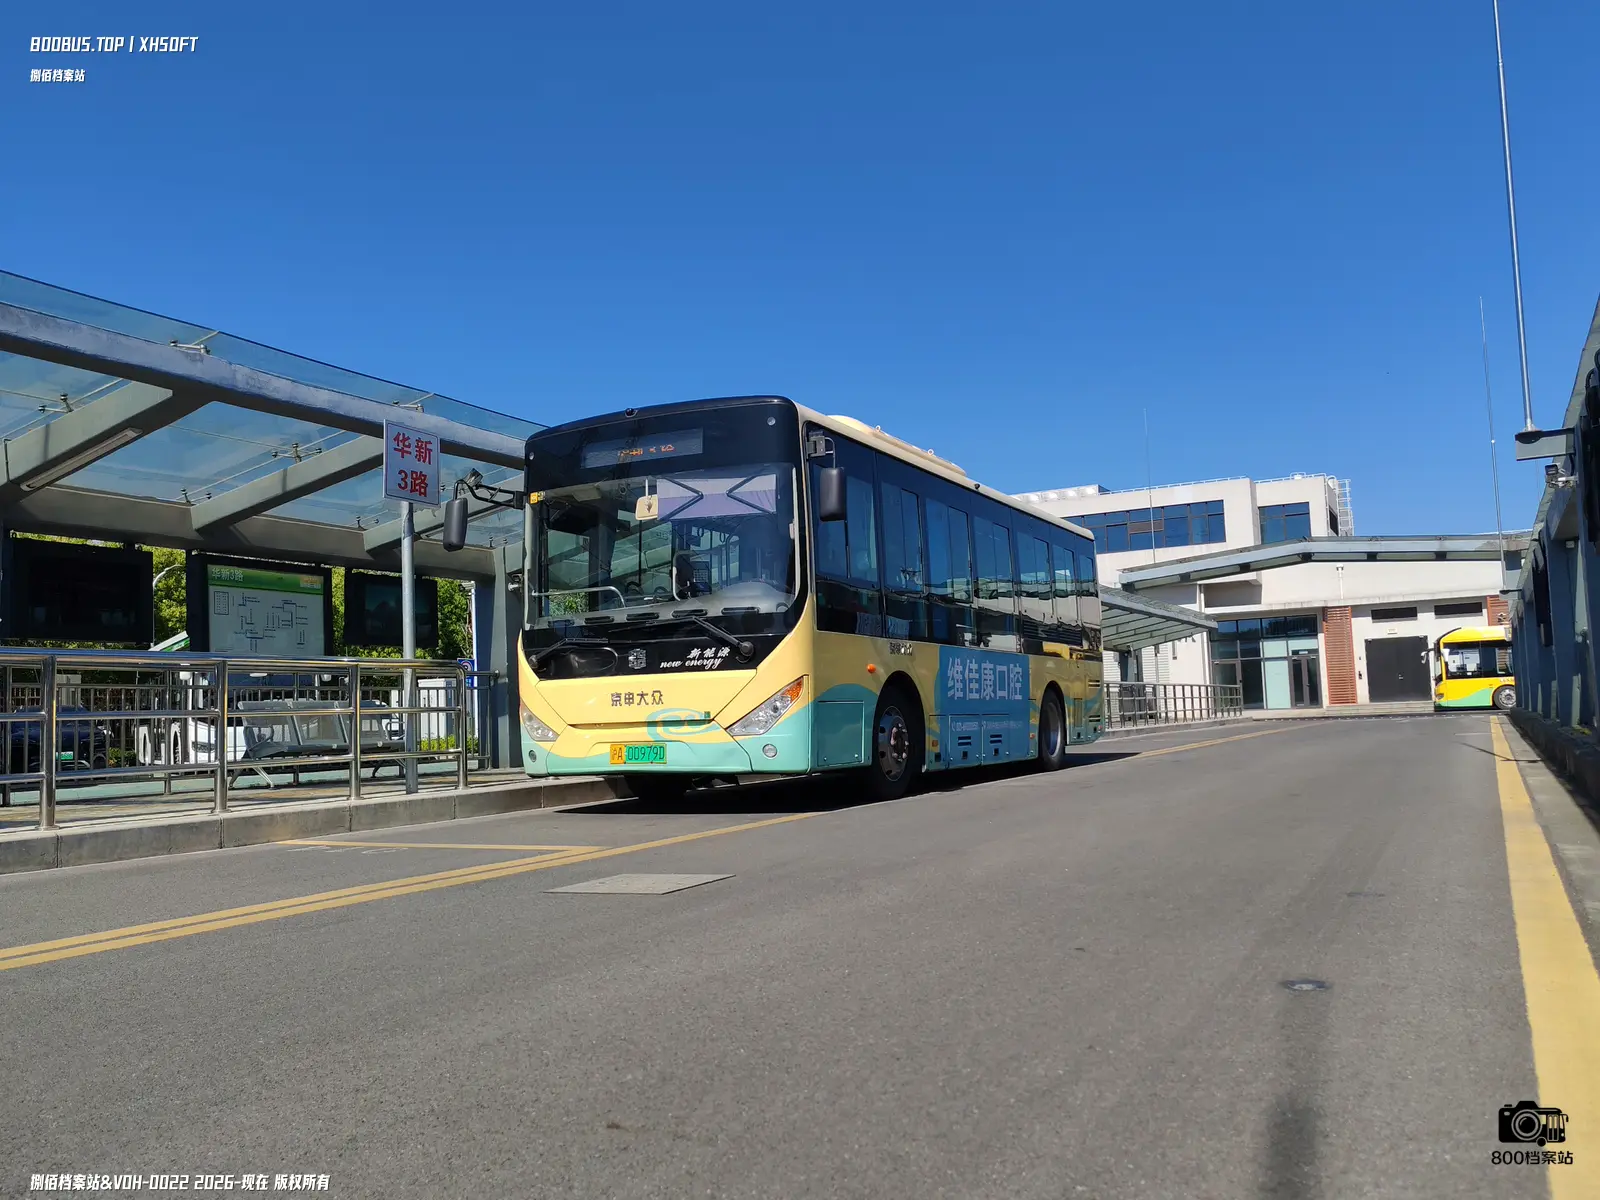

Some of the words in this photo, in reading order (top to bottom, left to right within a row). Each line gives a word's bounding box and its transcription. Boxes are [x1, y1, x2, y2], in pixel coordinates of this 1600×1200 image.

[393, 431, 433, 465] 华新
[397, 469, 429, 497] 3路
[212, 567, 244, 582] 华新3路
[687, 646, 731, 660] 新能源
[660, 660, 682, 668] new
[685, 657, 724, 670] energy
[947, 656, 1023, 700] 维佳康口腔
[611, 690, 664, 707] 京申大众
